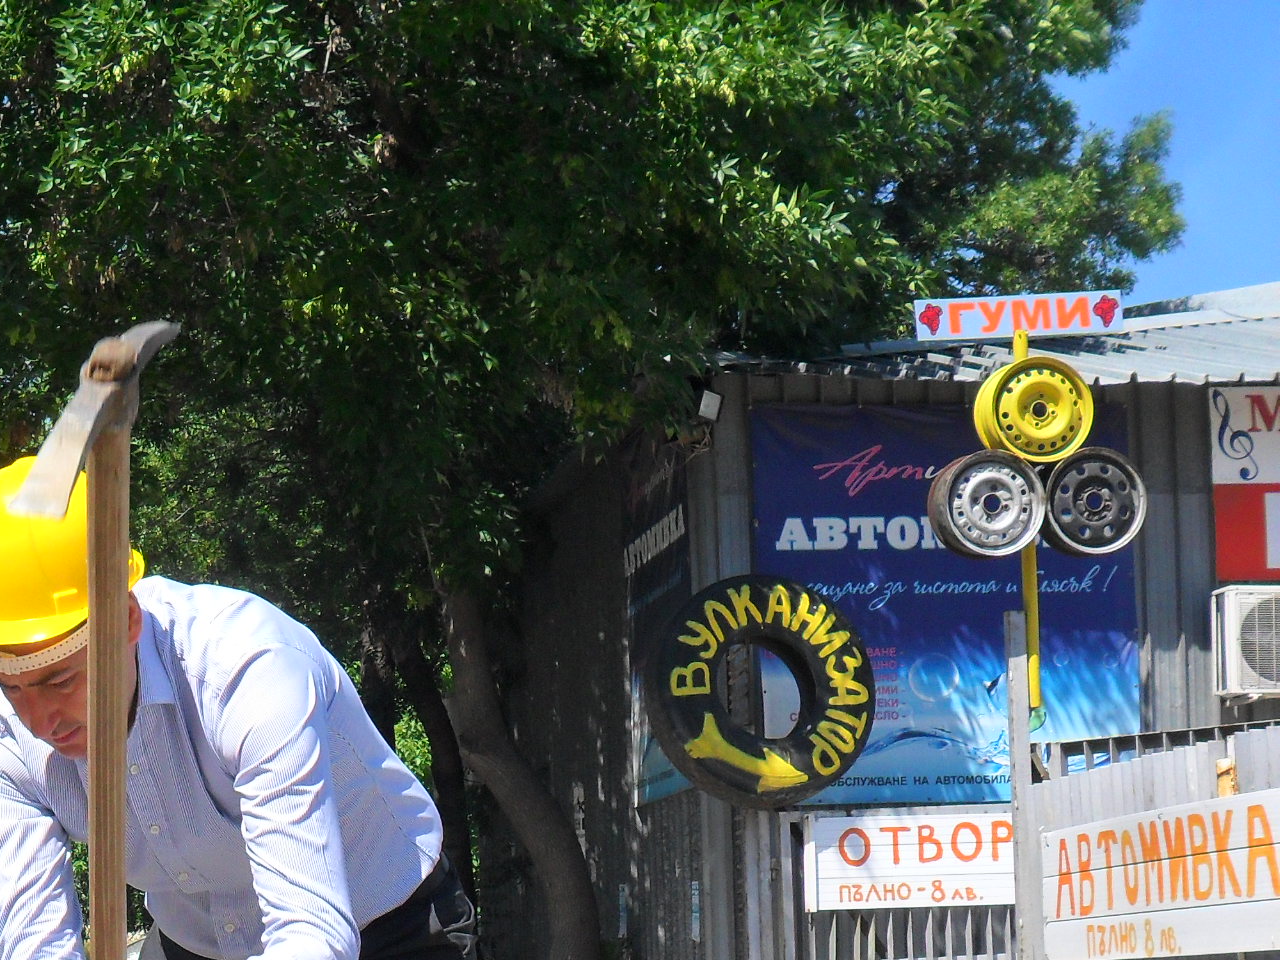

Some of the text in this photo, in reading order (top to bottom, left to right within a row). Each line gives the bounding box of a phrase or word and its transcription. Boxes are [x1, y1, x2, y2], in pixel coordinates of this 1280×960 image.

[948, 297, 1092, 334] ГУМИ
[868, 581, 907, 611] за
[913, 580, 1000, 594] чистота
[1037, 564, 1101, 593] лясък
[671, 584, 869, 776] ВУЛКАНИЗАТОР
[913, 776, 929, 785] НА
[838, 820, 1013, 867] ОТВОР
[1056, 804, 1280, 919] АВТОМИВКА
[931, 880, 946, 903] 8
[1144, 918, 1155, 958] 8
